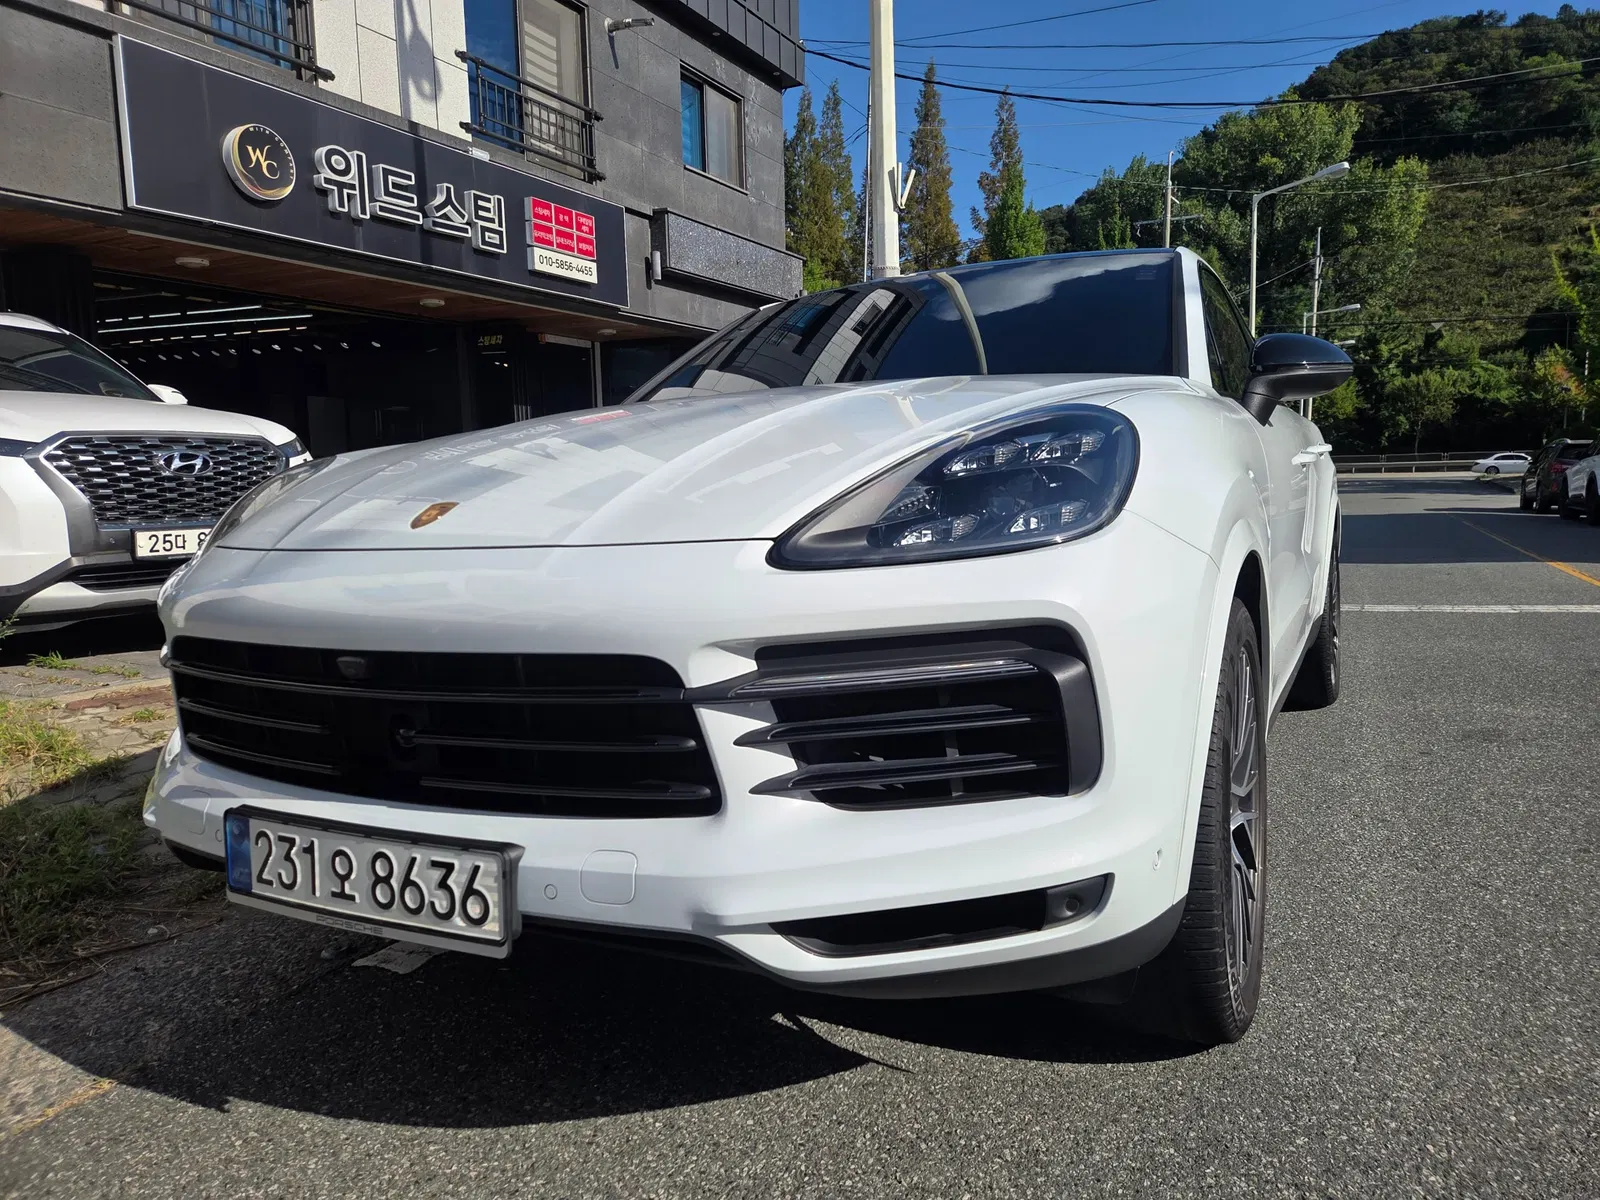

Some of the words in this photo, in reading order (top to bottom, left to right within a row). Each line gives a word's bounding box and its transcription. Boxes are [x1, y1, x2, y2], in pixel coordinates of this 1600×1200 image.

[313, 145, 507, 254] 위드스팀
[538, 254, 593, 276] 010-5856-4455
[148, 533, 187, 553] 25다
[370, 848, 493, 926] 8636
[316, 914, 383, 936] PORSCHE
